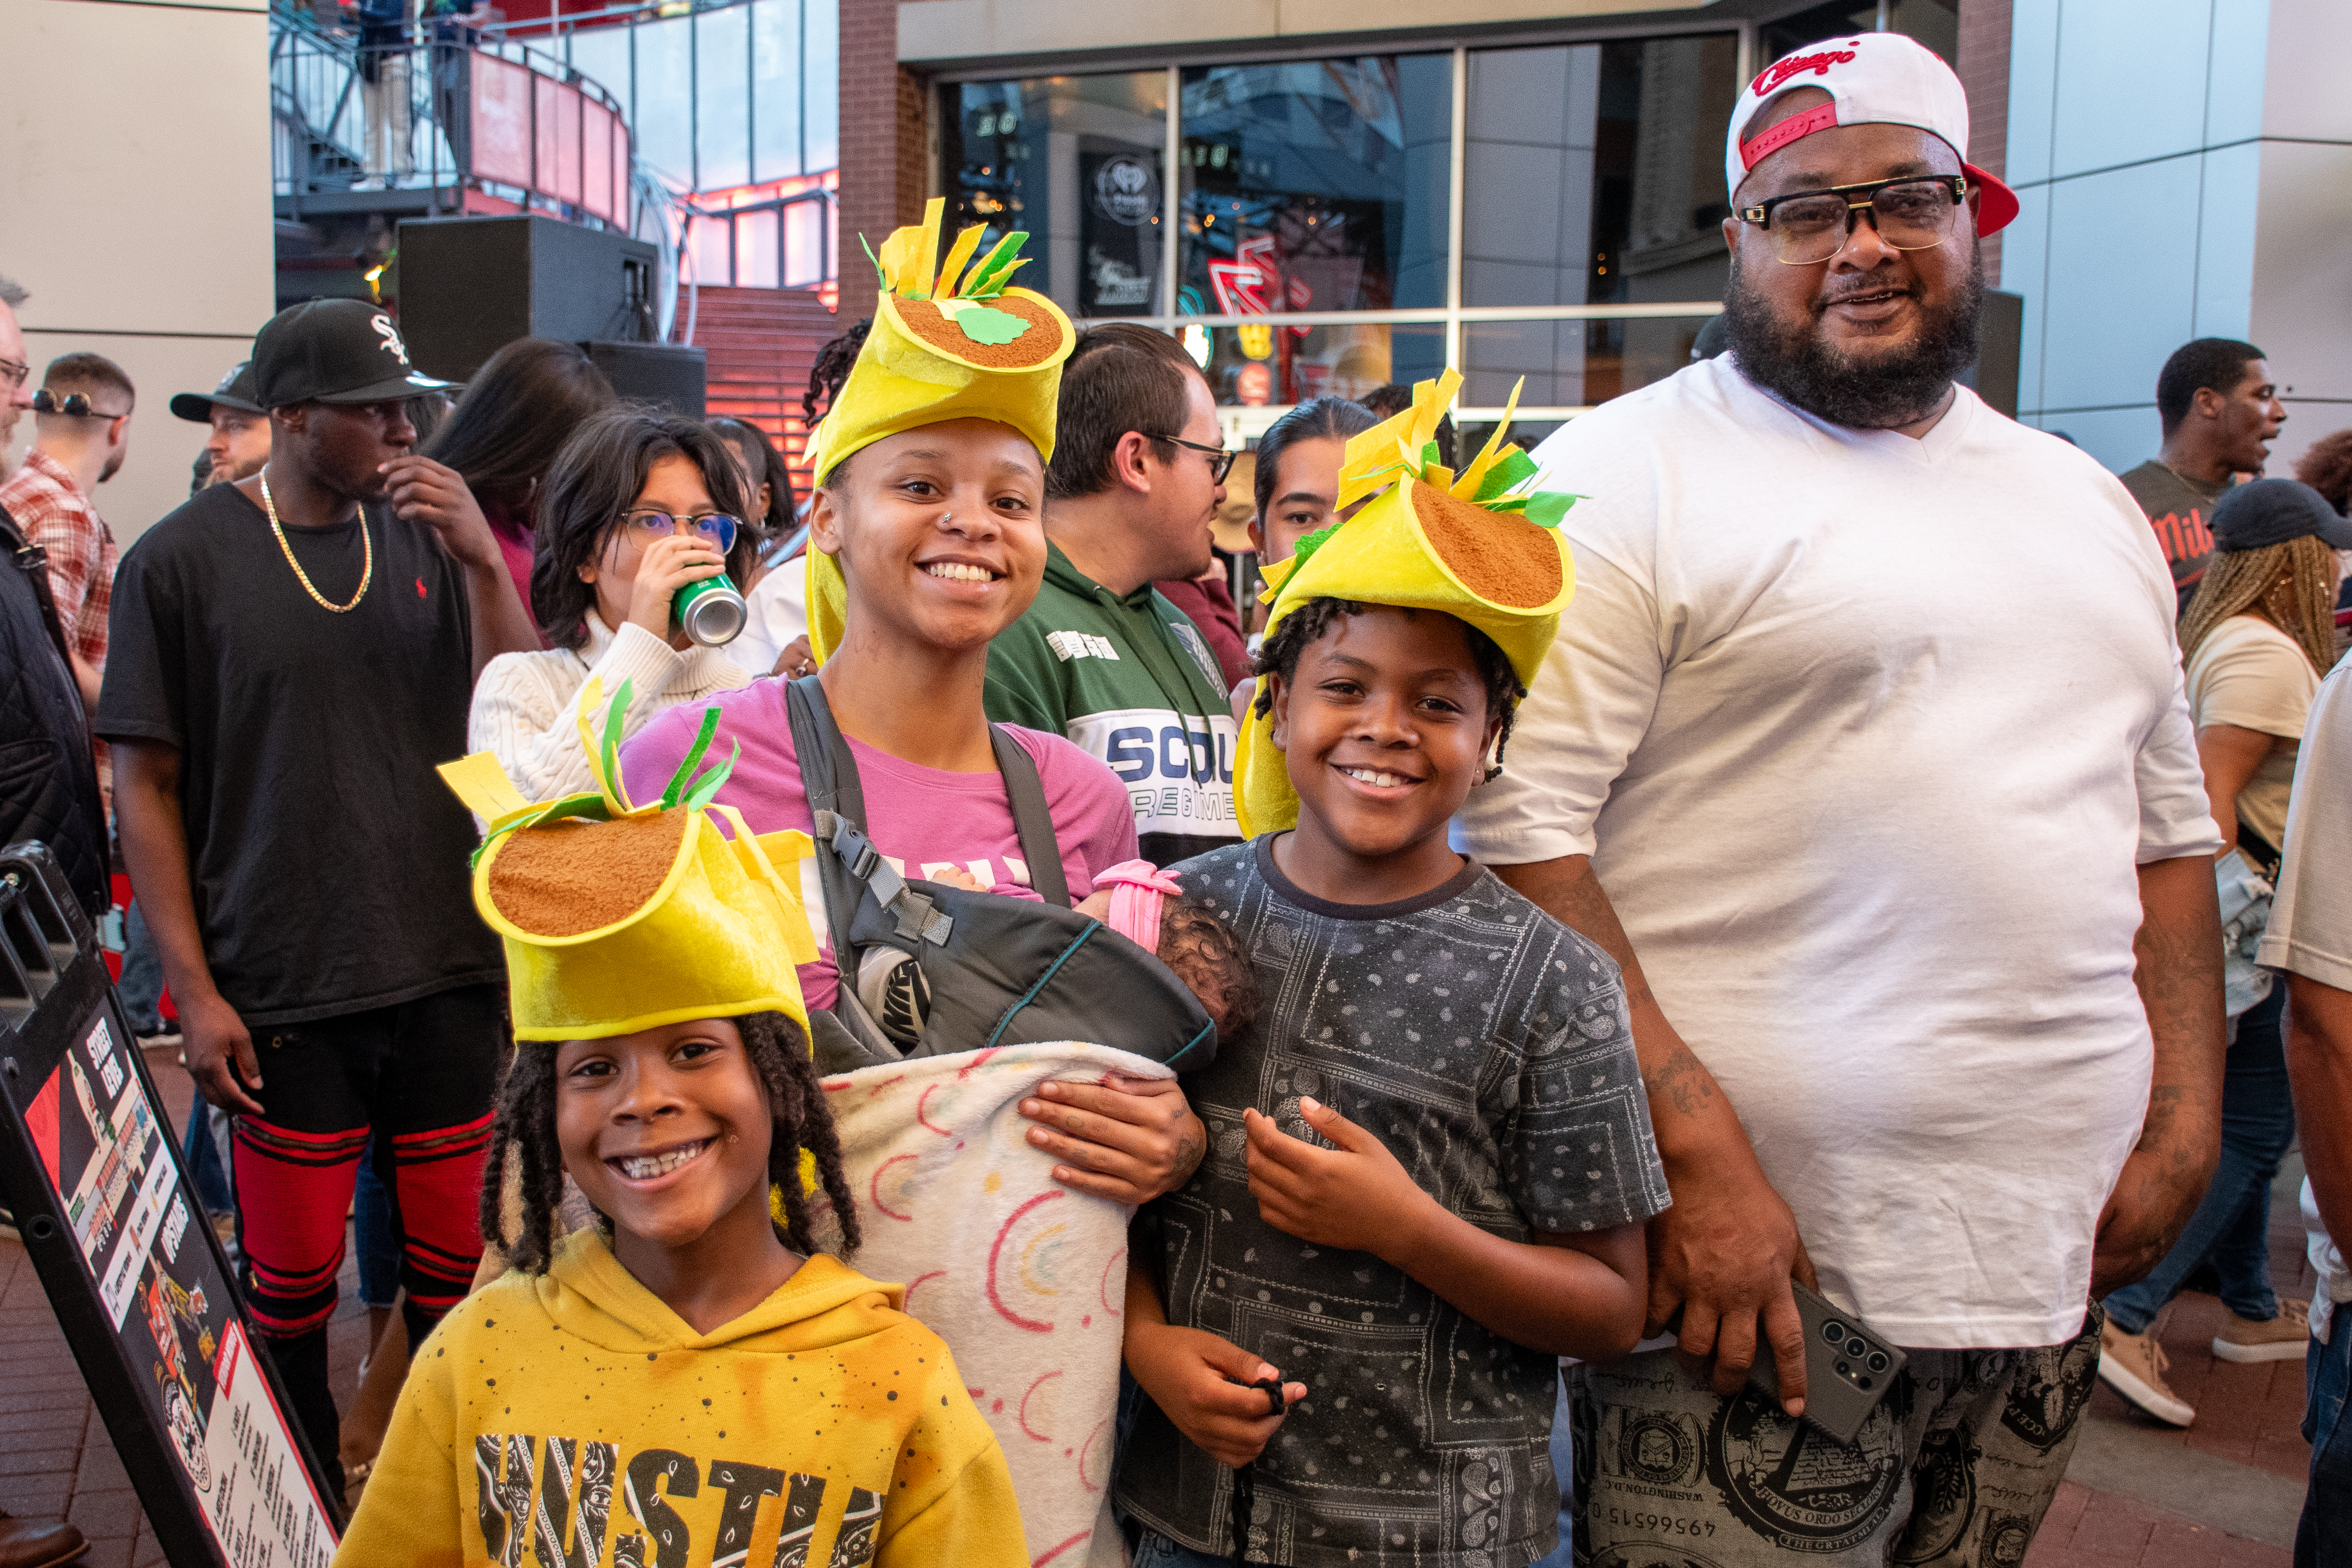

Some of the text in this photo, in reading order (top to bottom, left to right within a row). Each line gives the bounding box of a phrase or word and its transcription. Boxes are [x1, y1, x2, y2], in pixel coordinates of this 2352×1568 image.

[1752, 51, 1855, 97] Chicago
[370, 314, 409, 365] Sox
[86, 1017, 113, 1070] STREET
[100, 1052, 124, 1099] LEVEL
[161, 1192, 189, 1264] UPSTAIRS
